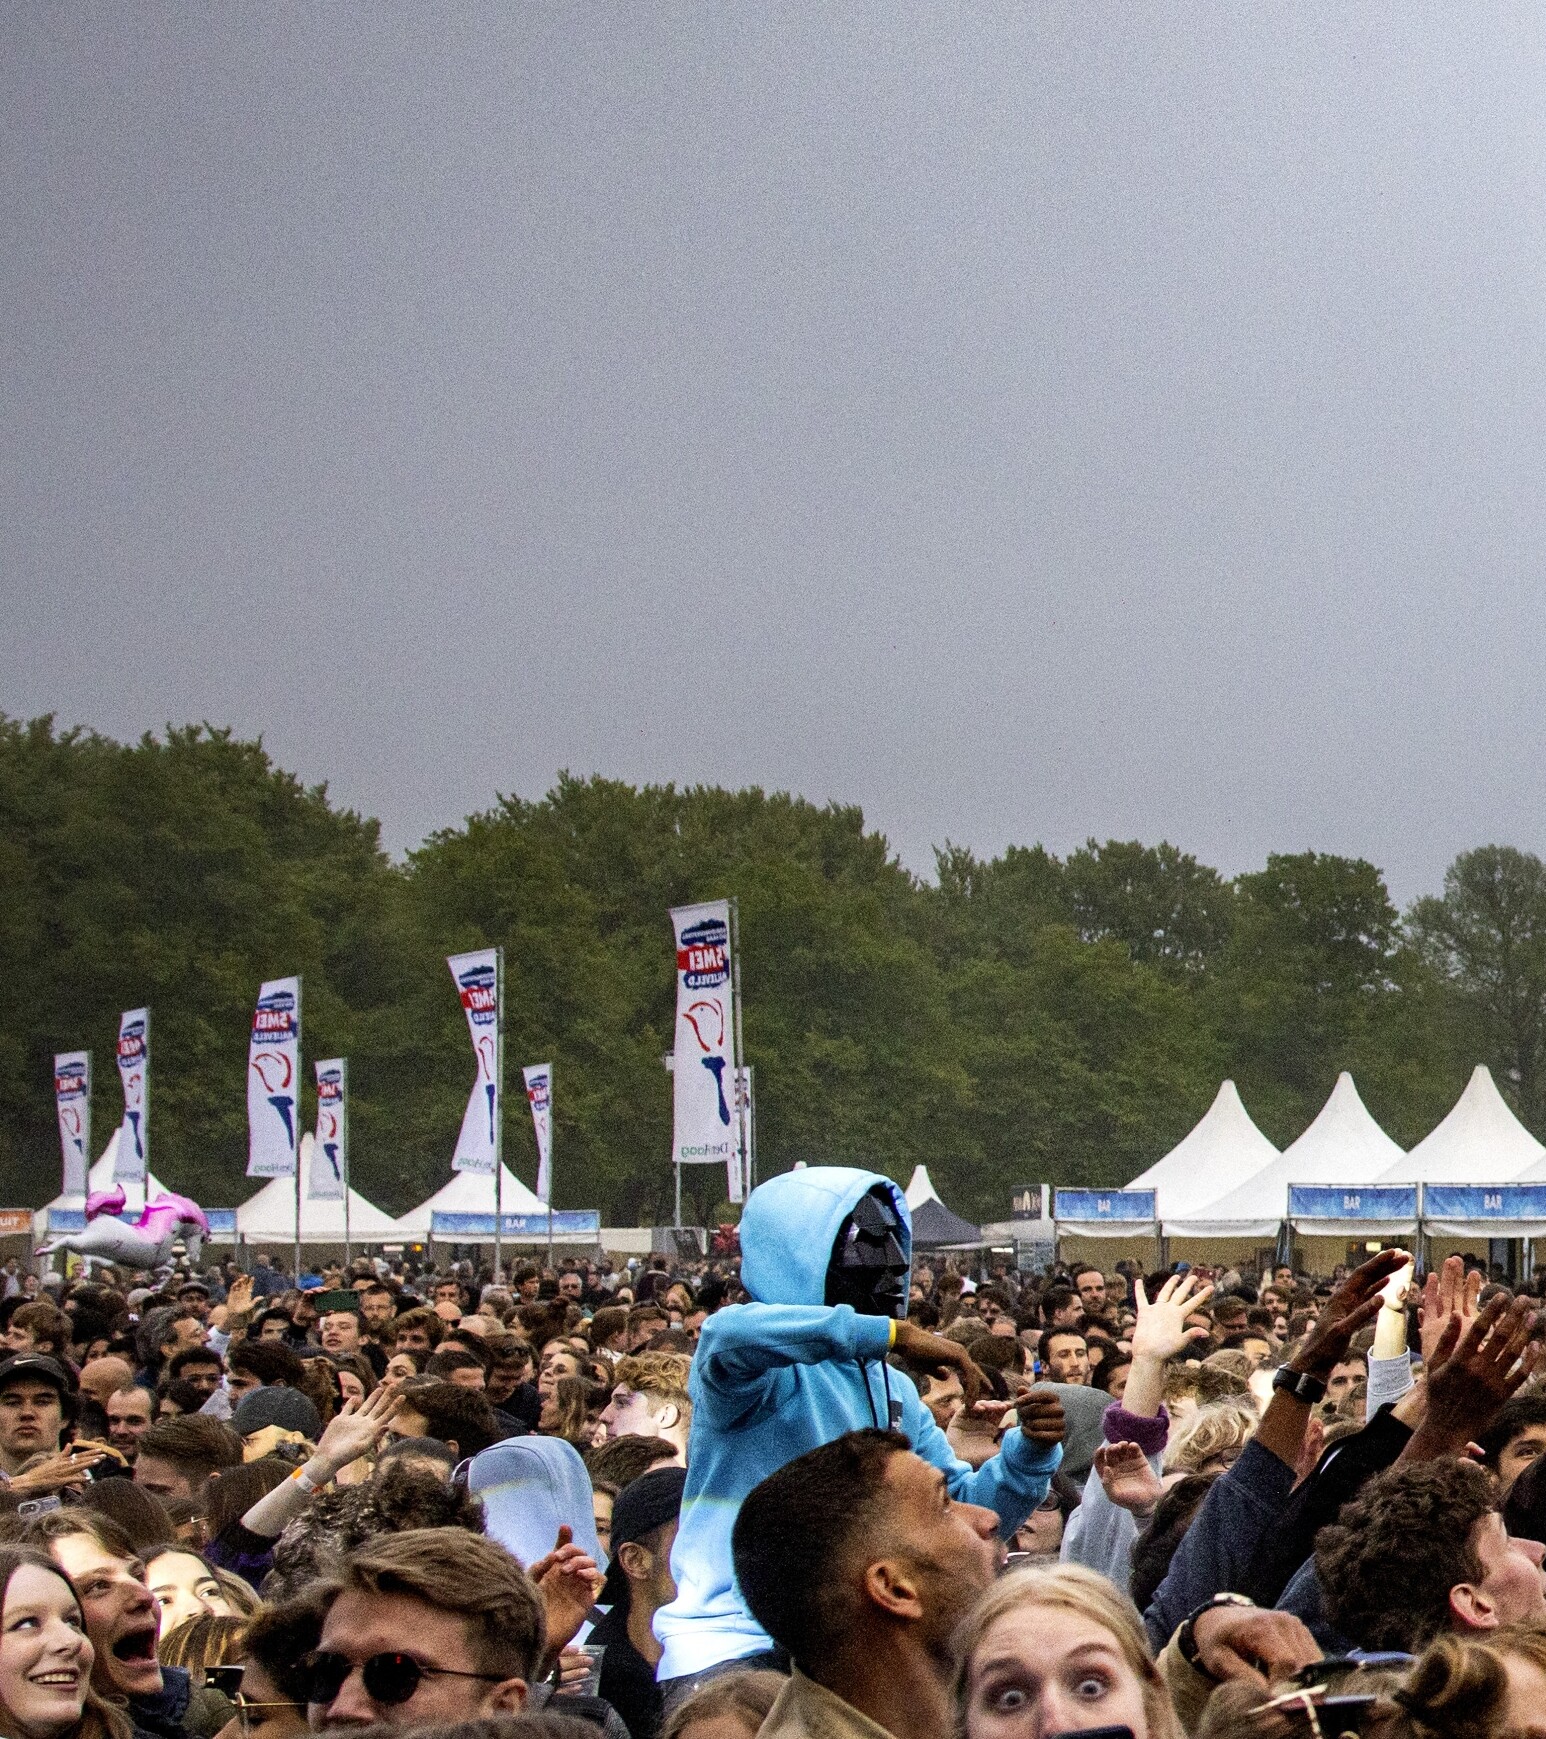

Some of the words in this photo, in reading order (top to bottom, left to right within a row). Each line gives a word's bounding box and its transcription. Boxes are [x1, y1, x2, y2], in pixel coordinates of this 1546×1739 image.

[1097, 1199, 1111, 1213] BAR
[1343, 1194, 1361, 1210] BAR
[1484, 1194, 1502, 1211] BAR
[505, 1218, 527, 1229] BAR
